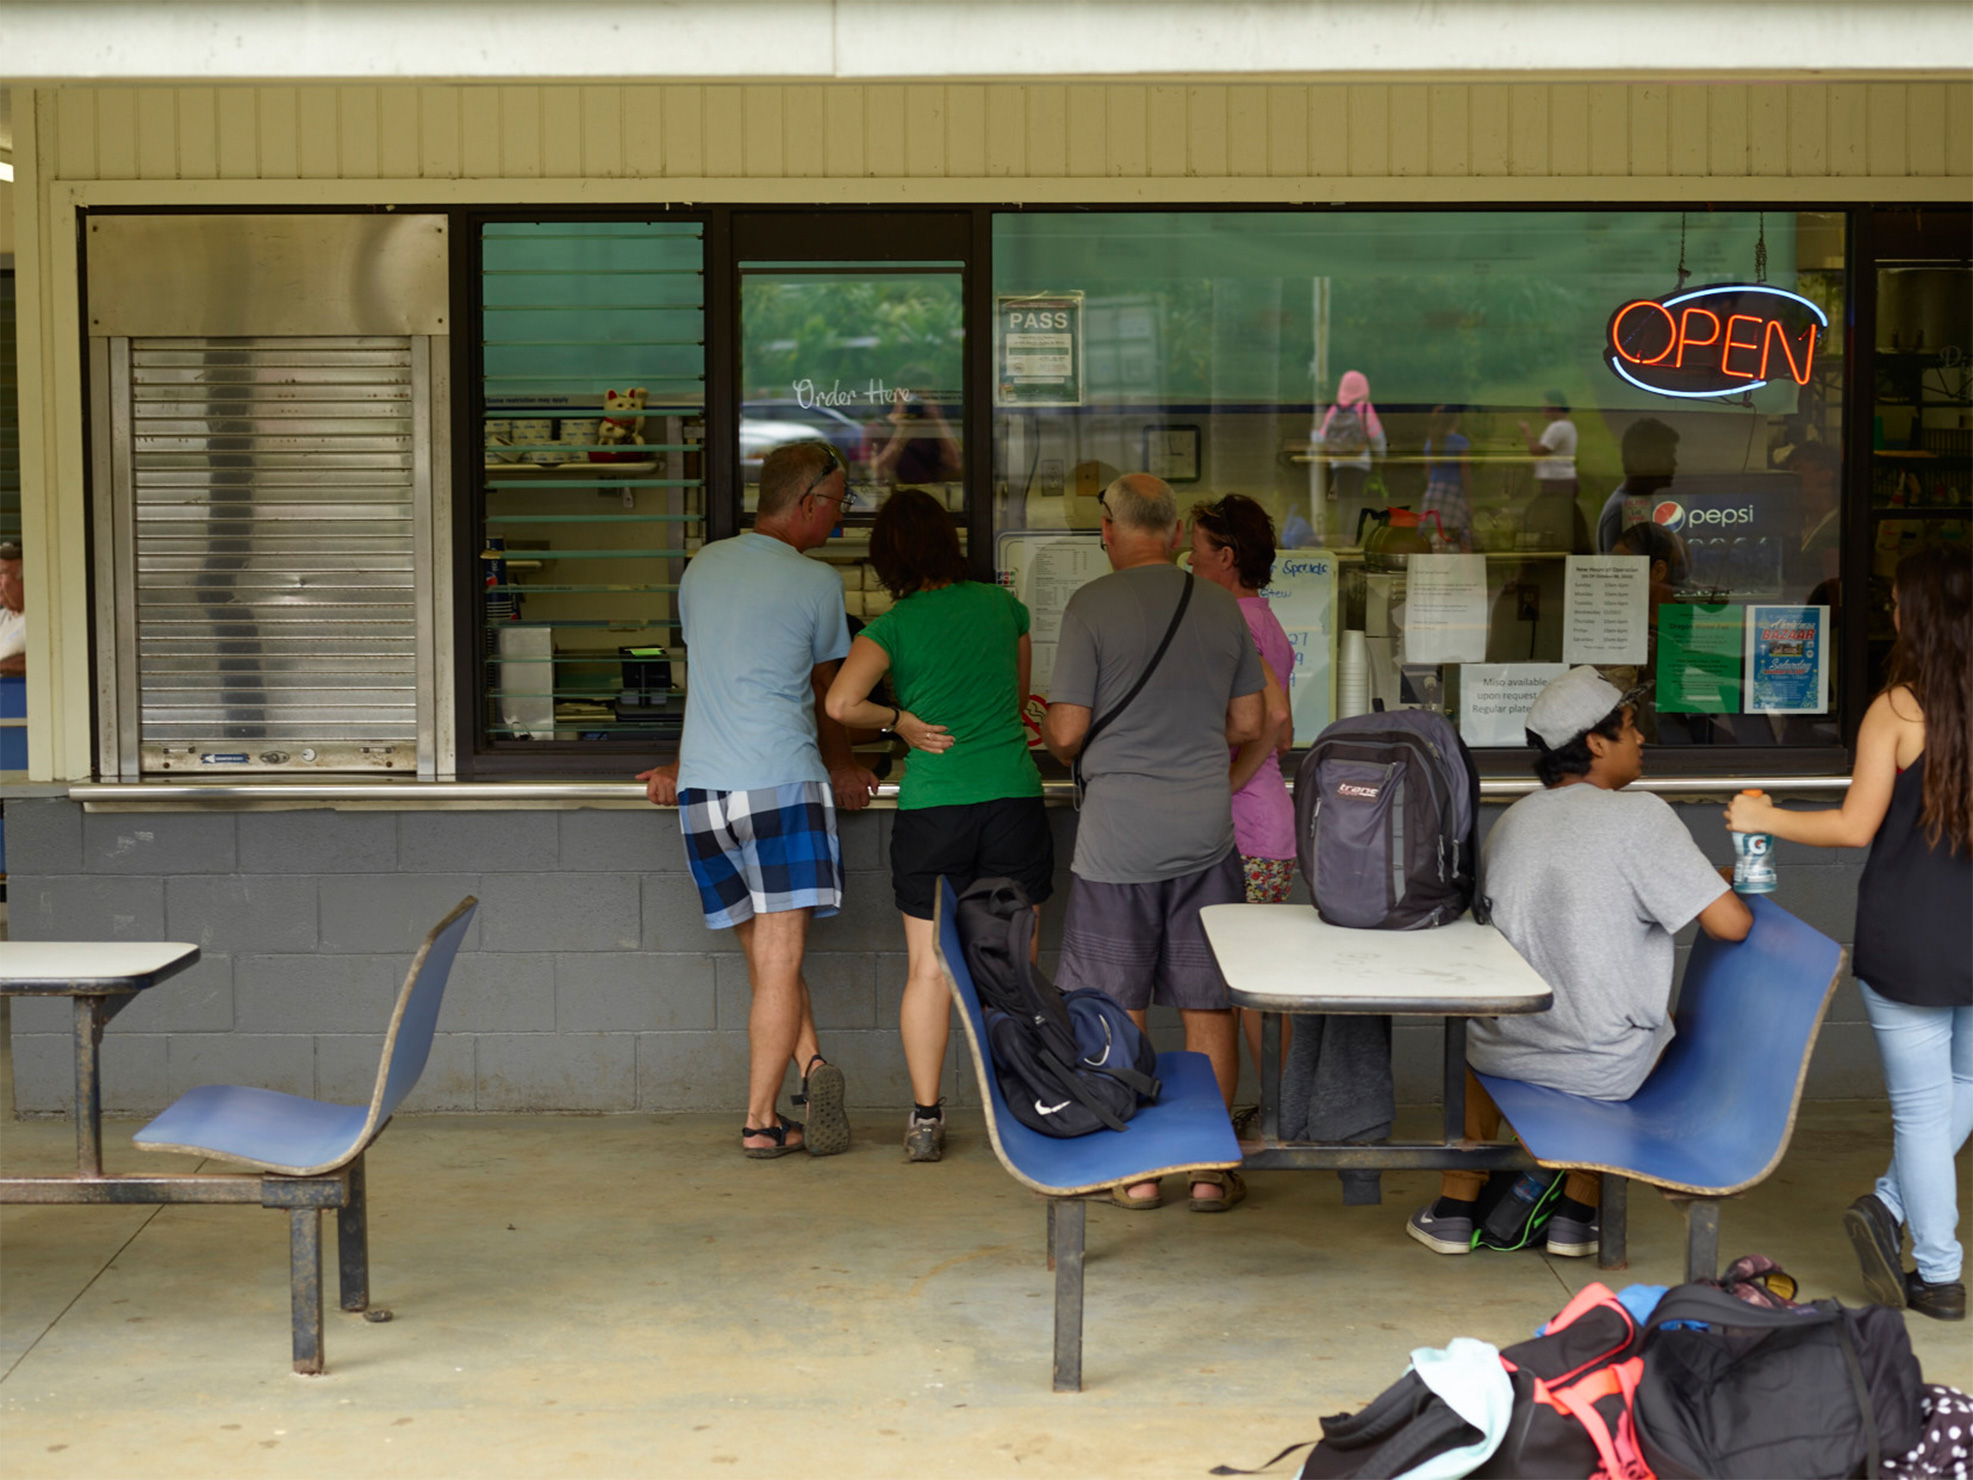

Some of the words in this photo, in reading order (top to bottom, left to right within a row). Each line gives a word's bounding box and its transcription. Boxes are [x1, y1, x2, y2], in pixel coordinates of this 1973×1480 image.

[1009, 312, 1068, 329] PASS
[1612, 300, 1817, 386] OPEN
[793, 378, 856, 410] Order
[863, 378, 910, 405] Here
[1688, 504, 1754, 529] pepsi
[1761, 629, 1815, 640] BAZAAR
[1769, 658, 1812, 674] Saturday
[1483, 678, 1505, 686] Miso
[1507, 678, 1548, 687] available
[1477, 692, 1501, 701] upon
[1503, 691, 1537, 701] request
[1472, 704, 1506, 715] Regular
[1748, 835, 1767, 855] G
